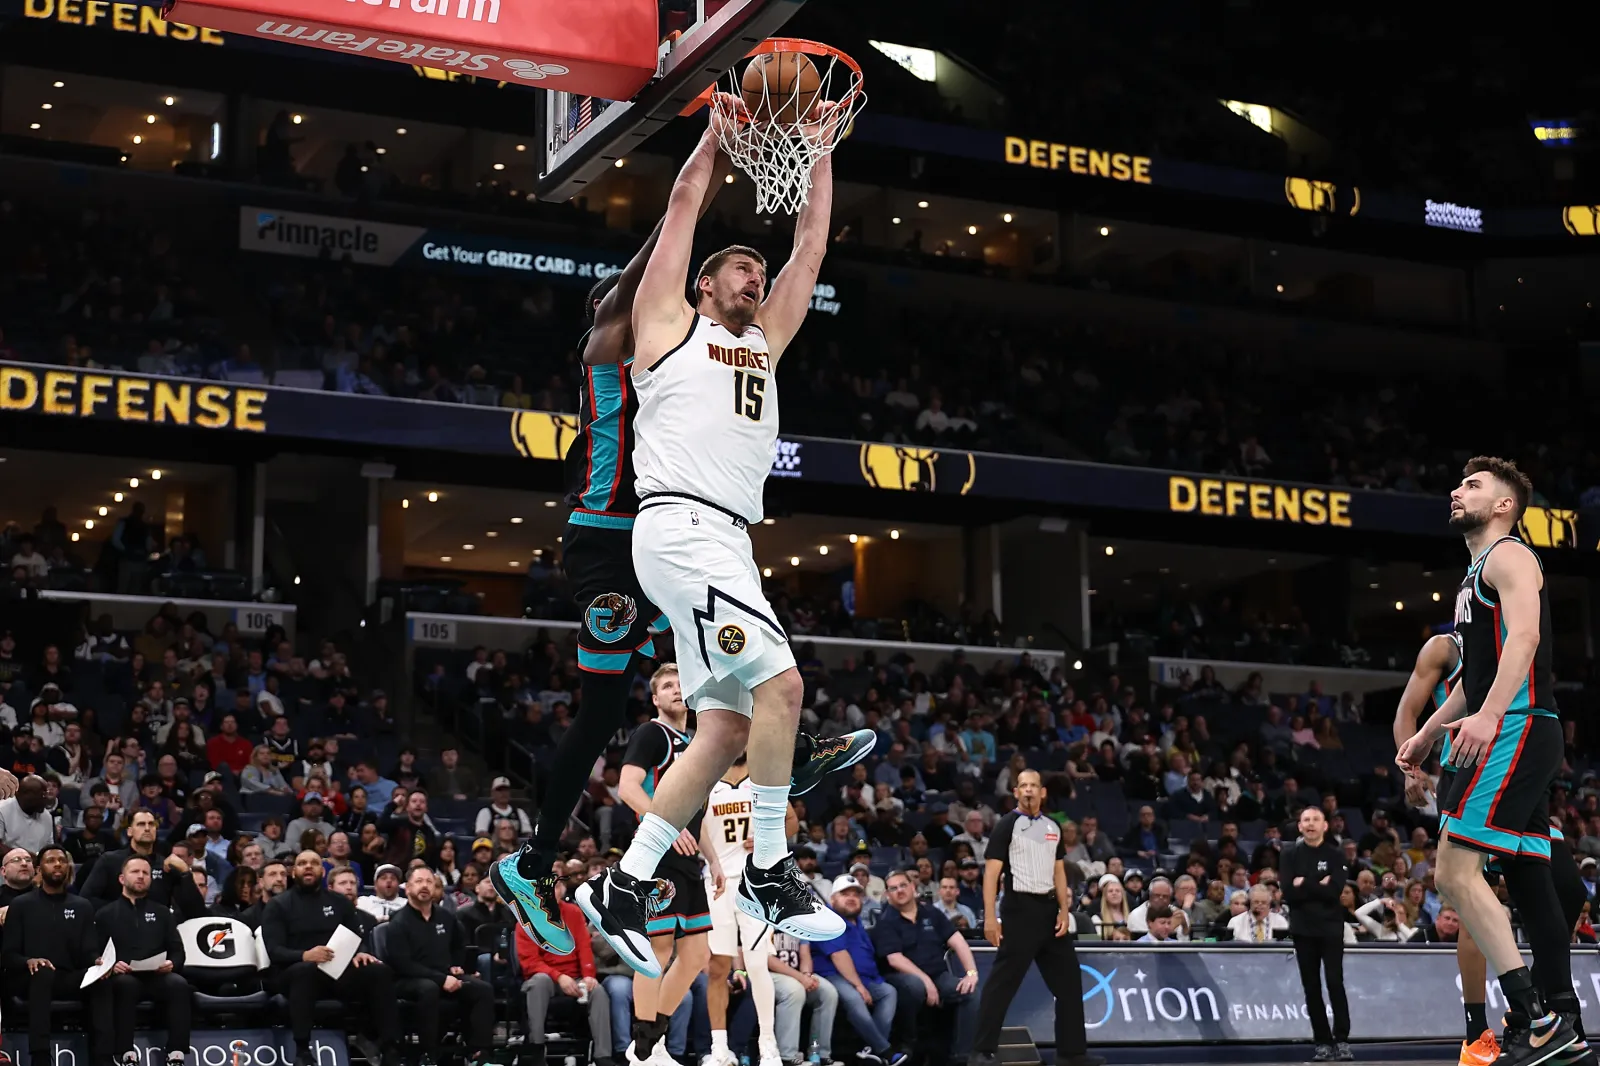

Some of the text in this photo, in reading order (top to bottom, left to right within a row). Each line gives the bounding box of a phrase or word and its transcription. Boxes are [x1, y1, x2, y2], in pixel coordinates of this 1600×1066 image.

[24, 0, 225, 46] DEFENSE
[1004, 137, 1152, 184] DEFENSE
[257, 212, 379, 253] Pinnacle
[422, 242, 450, 261] Get
[451, 245, 485, 265] Your
[486, 249, 534, 271] GRIZZ
[534, 254, 577, 276] CARD
[577, 261, 593, 278] at
[707, 343, 771, 373] NUGGET
[0, 367, 268, 432] DEFENSE
[734, 369, 767, 423] 15
[1168, 475, 1353, 528] DEFENSE
[421, 623, 449, 639] 105
[723, 817, 750, 843] 27
[196, 922, 236, 960] G
